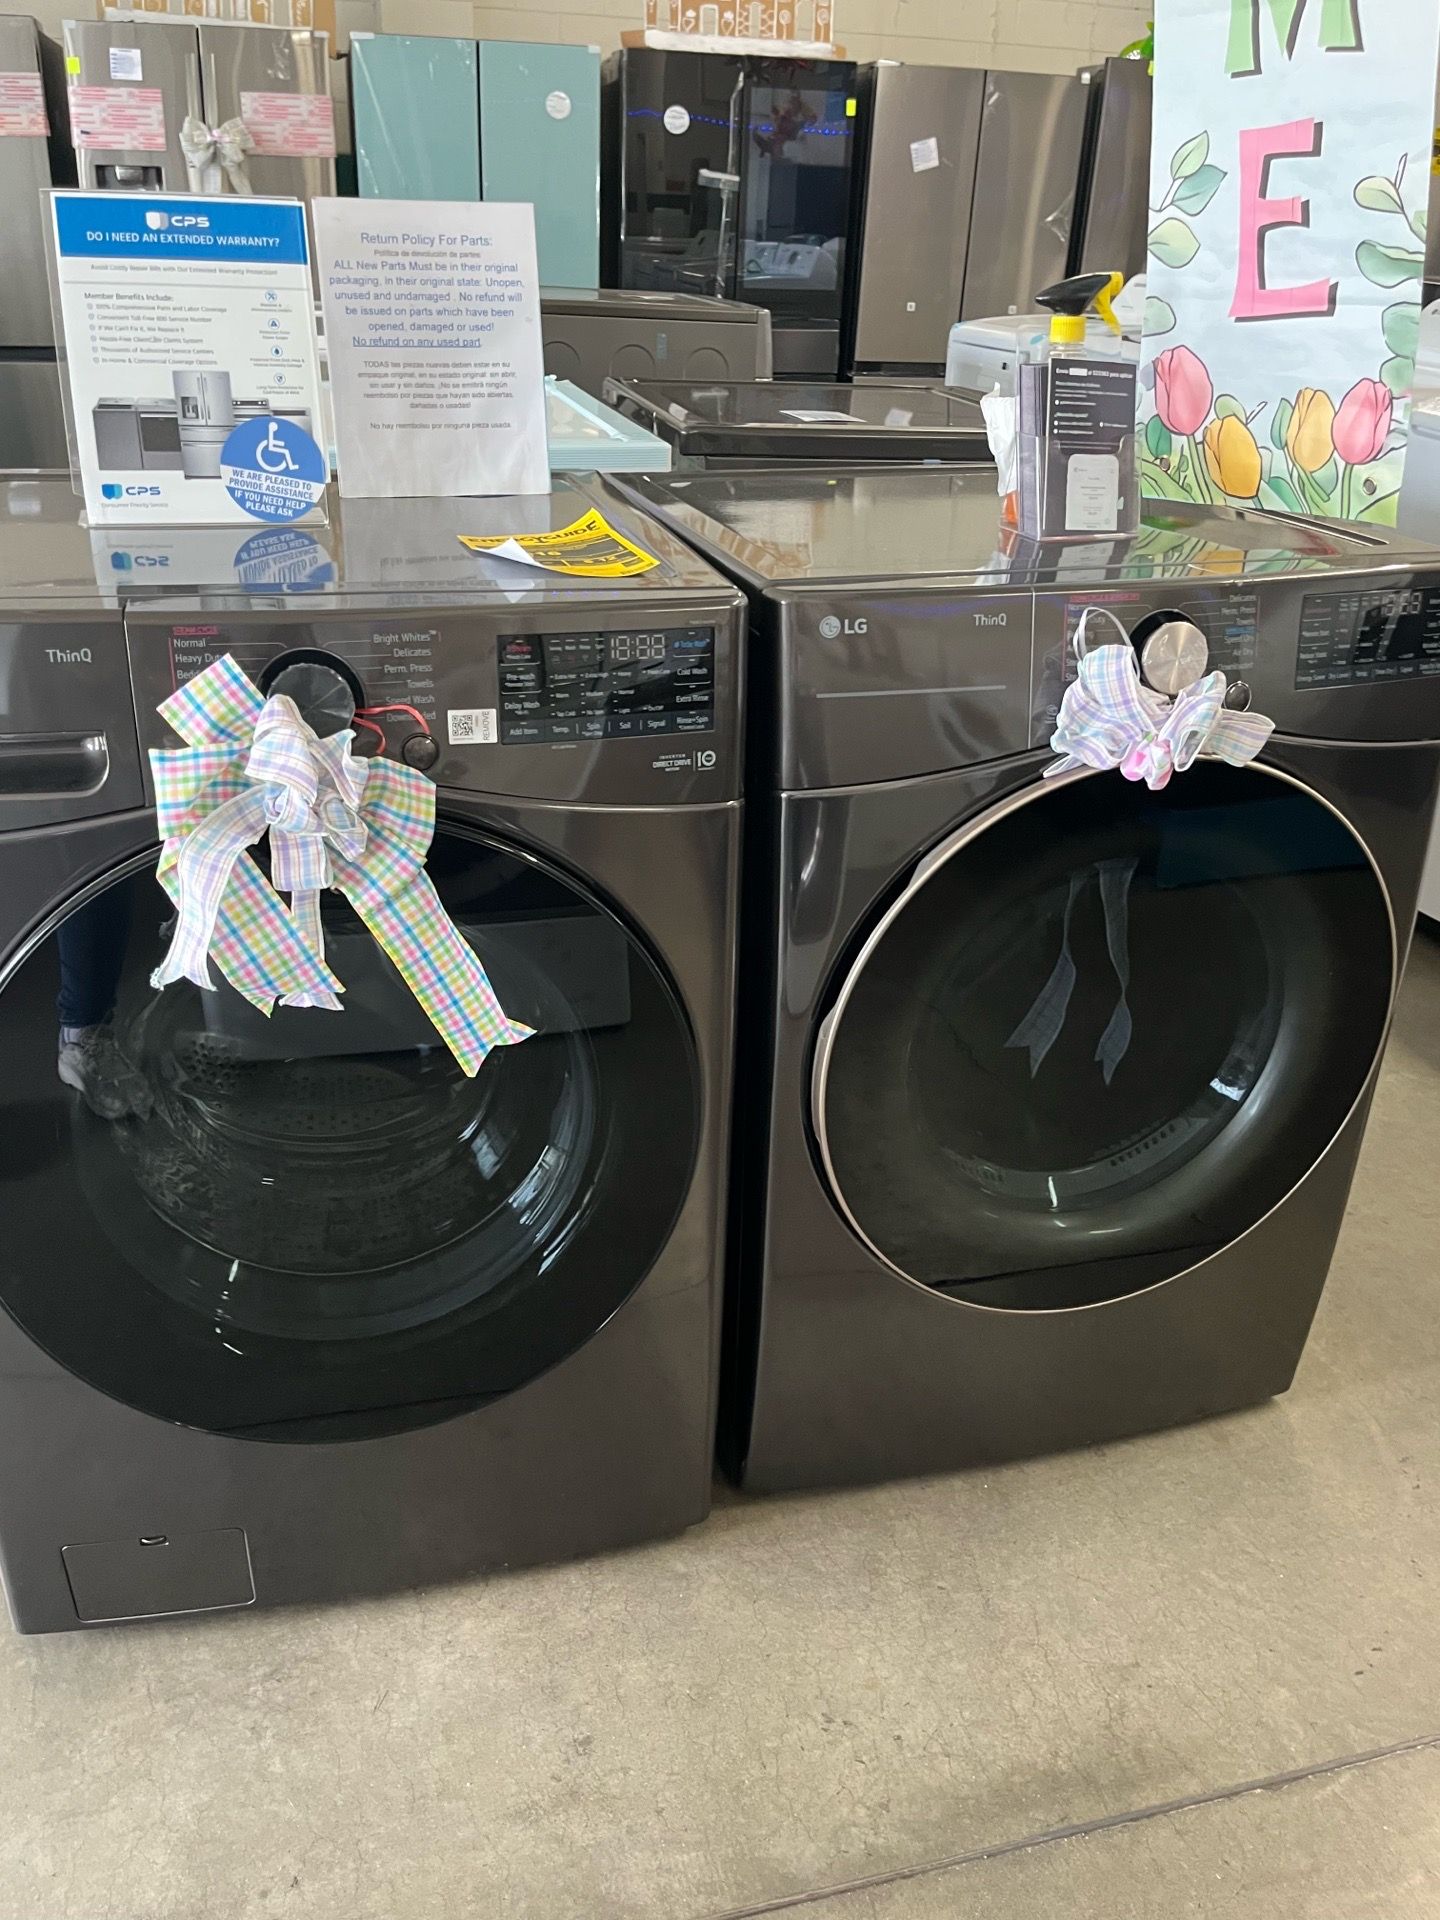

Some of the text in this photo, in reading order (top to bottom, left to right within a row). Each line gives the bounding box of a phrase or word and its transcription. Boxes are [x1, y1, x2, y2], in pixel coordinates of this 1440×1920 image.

[171, 216, 210, 228] CPS
[1228, 117, 1338, 323] E
[86, 231, 280, 247] DO I NEED AN EXTENDED WARRANTY?
[360, 232, 493, 248] Return Policy For Parts:
[333, 259, 518, 274] ALL New Parts Must be in their original
[395, 276, 417, 285] their
[419, 277, 454, 288] original
[84, 292, 114, 300] Member
[115, 293, 144, 301] Benefits
[334, 291, 522, 303] unused and undamaged No refund will
[345, 305, 514, 317] be issued on parts which have been
[409, 322, 454, 333] damaged
[468, 322, 494, 332] used!
[352, 335, 460, 347] No refund on any used
[232, 469, 312, 491] WE ARE PLEASED TO
[126, 486, 161, 496] CPS
[229, 477, 314, 500] PROVIDE ASSISTANCE
[234, 489, 306, 510] IF YOU NEED HELP
[245, 501, 294, 517] PLEASE ASK
[844, 618, 868, 634] LG
[973, 613, 1007, 627] ThinQ
[173, 638, 206, 648] Normal
[373, 633, 399, 646] Bright
[46, 648, 92, 663] ThinQ
[175, 653, 202, 665] Heavy
[393, 648, 432, 658] Delicates
[384, 663, 433, 673] Perm. Press
[406, 679, 434, 688] Towels
[412, 694, 435, 704] Wash
[674, 758, 692, 766] DRIVE
